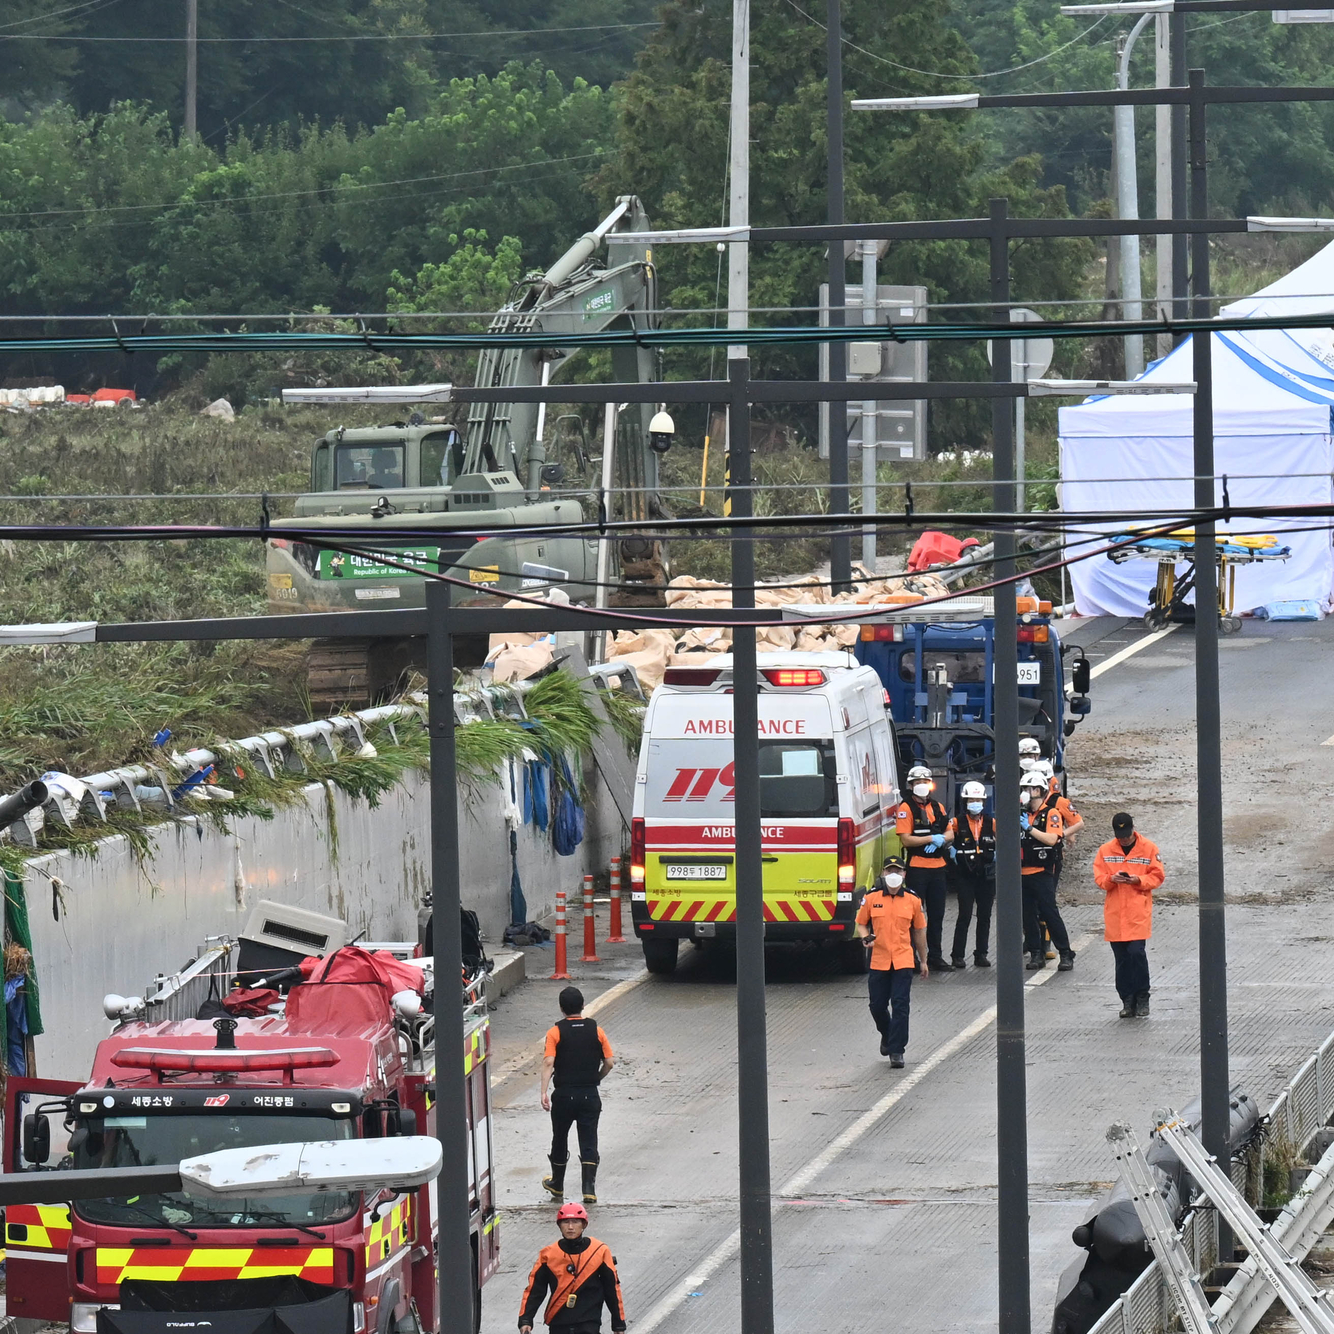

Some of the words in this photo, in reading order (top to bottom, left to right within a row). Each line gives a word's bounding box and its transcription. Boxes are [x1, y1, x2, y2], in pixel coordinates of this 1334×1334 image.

[353, 568, 379, 576] Republic
[698, 866, 723, 877] 1887
[130, 1096, 173, 1108] 세종소방
[203, 1093, 231, 1107] 119
[253, 1096, 295, 1108] 어진중펌
